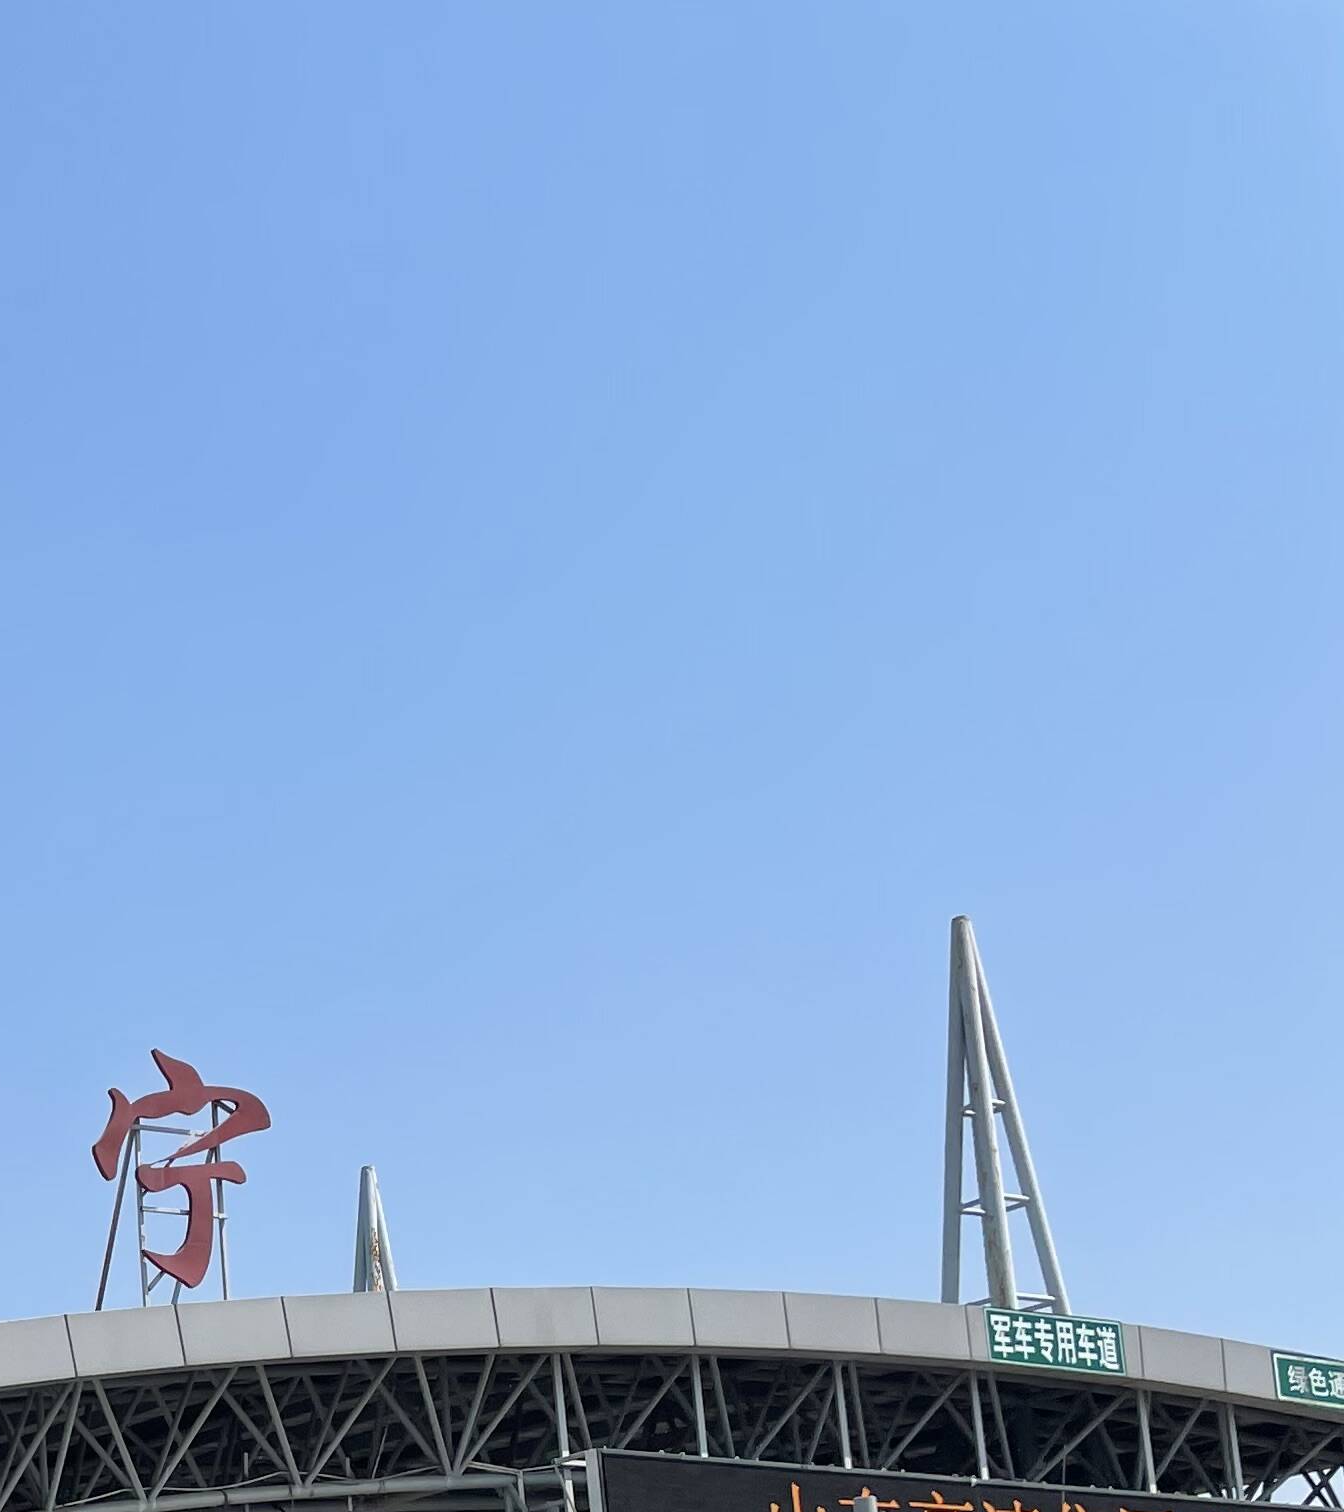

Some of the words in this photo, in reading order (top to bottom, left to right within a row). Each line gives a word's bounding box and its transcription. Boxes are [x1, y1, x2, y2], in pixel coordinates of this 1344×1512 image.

[989, 1313, 1121, 1371] 军车专用车道
